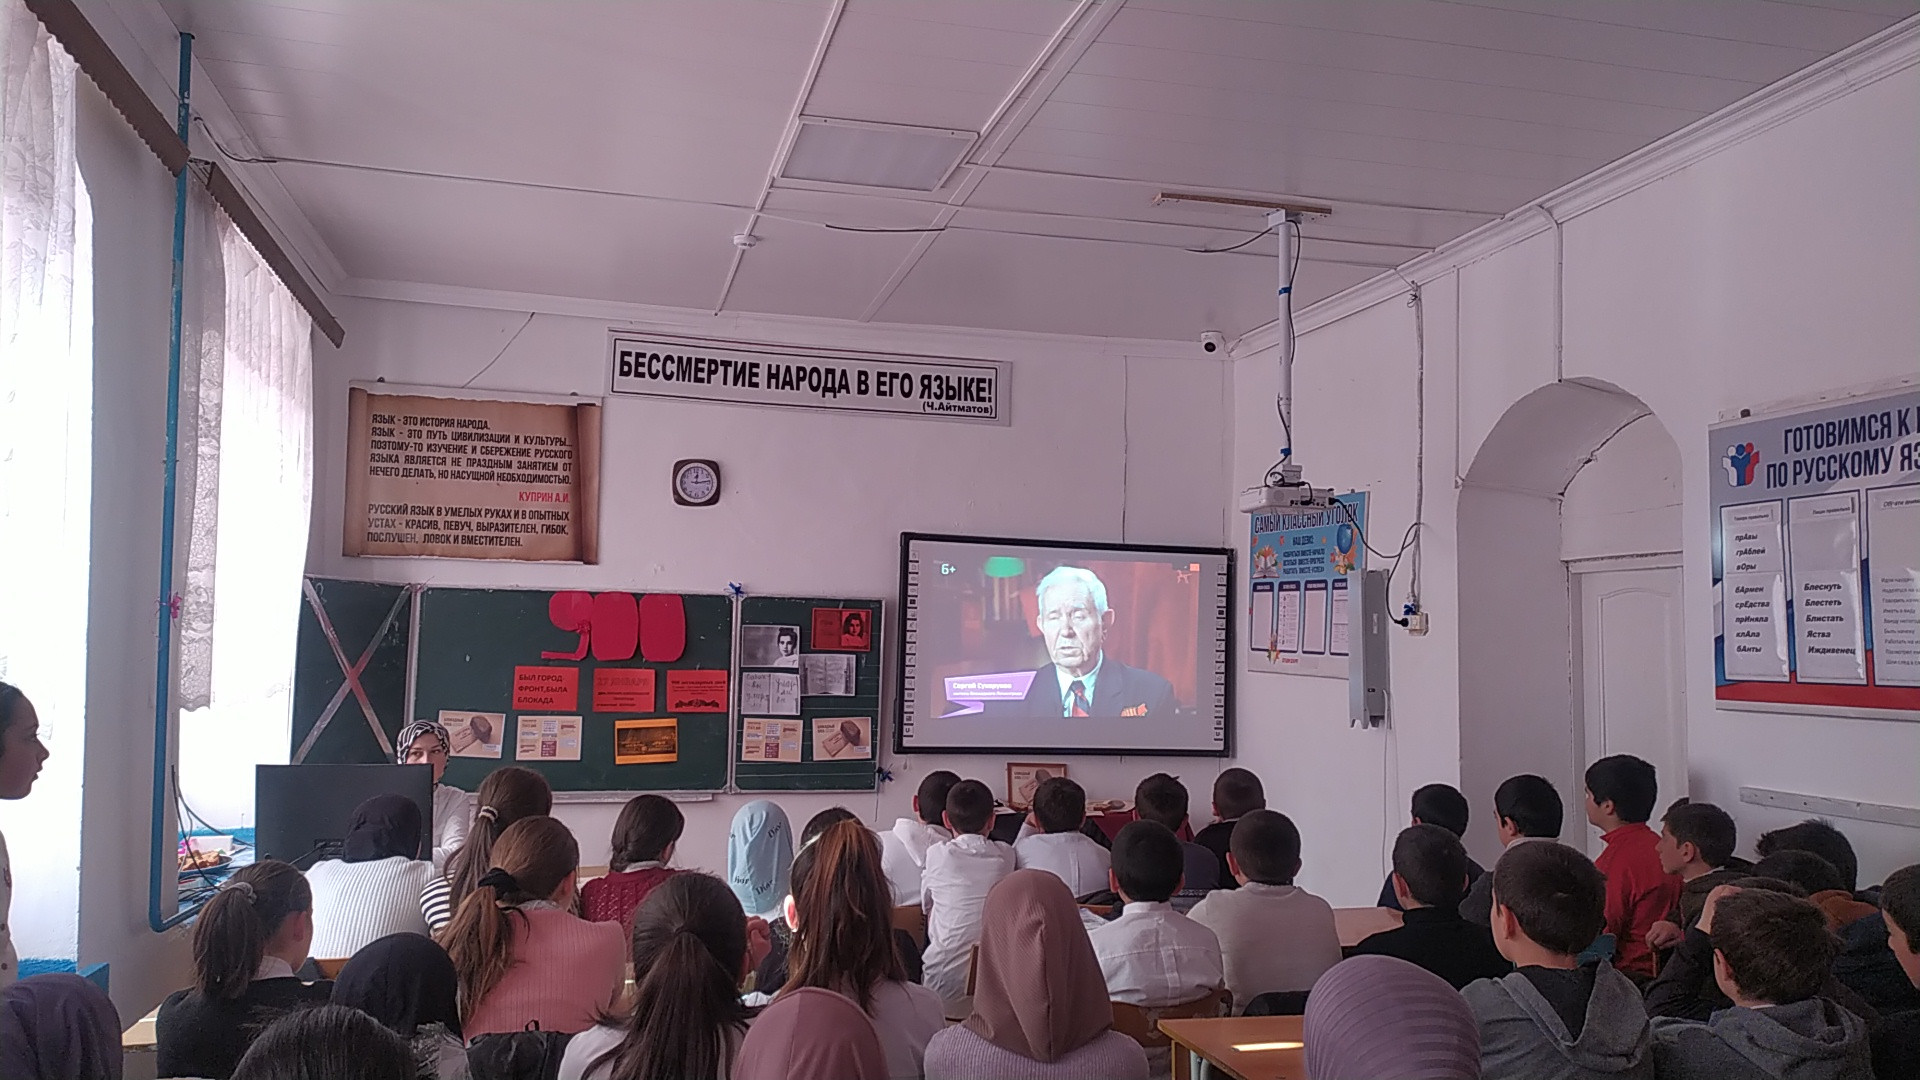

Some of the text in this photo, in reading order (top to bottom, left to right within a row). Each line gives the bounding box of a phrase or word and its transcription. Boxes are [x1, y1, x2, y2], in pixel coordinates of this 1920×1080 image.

[619, 350, 993, 403] БЕССМЕРТИЕ НАРОДА В ЕГО ЯЗЫКЕ!
[922, 401, 993, 415] (Ч.Айтматов)
[371, 414, 396, 425] ЯЗЫК
[403, 416, 418, 426] ЭТО
[419, 416, 455, 428] ИСТОРИЯ
[456, 418, 490, 430] НАРОДА.
[371, 427, 395, 437] ЯЗЫК
[407, 429, 422, 439] ЭТО
[426, 430, 447, 440] ПУТЬ
[451, 431, 510, 444] ЦИВИЛИЗАЦИИ
[514, 435, 520, 444] И
[523, 435, 572, 447] КУЛЬТУРЫ...
[1784, 407, 1910, 454] ГОТОВИМСЯ К
[371, 440, 572, 459] ПОЭТОМУ-ТО ИЗУЧЕНИЕ И СБЕРЕЖЕНИЕ РУССКОГО
[370, 453, 572, 472] ЯЗЫКА ЯВЛЯЕТСЯ НЕ ПРАЗДНЫМ ЗАНЯТИЕМ ОТ
[1766, 462, 1788, 489] ПО
[1793, 446, 1894, 486] РУССКОМУ
[369, 466, 571, 485] НЕЧЕГО ДЕЛАТЬ, НО НАСУЩНОЙ НЕОБХОДИМОСТЬЮ.
[519, 491, 553, 502] КУПРИН
[368, 503, 569, 521] РУССКИЙ ЯЗЫК В УМЕЛЫХ РУКАХ И В ОПЫТНЫХ
[368, 517, 396, 528] УСТАХ
[405, 519, 440, 531] КРАСИВ,
[443, 520, 473, 532] ПЕВУЧ,
[476, 521, 538, 534] ВЫРАЗИТЕЛЕН,
[541, 523, 568, 535] ГИБОК,
[367, 532, 523, 546] ПОСЛУШЕН, ЛОВОК И ВМЕСТИТЕЛЕН.
[1736, 546, 1766, 557] грАблей
[941, 563, 956, 575] 6+
[1736, 563, 1757, 572] вОры
[1804, 582, 1842, 592] Блеснуть
[1735, 600, 1770, 610] срЕдства
[1804, 598, 1842, 607] Блестеть
[1805, 614, 1844, 623] Блистать
[1807, 630, 1831, 639] Яства
[1808, 645, 1856, 656] Иждивенец
[517, 696, 554, 705] БЛОКАДА
